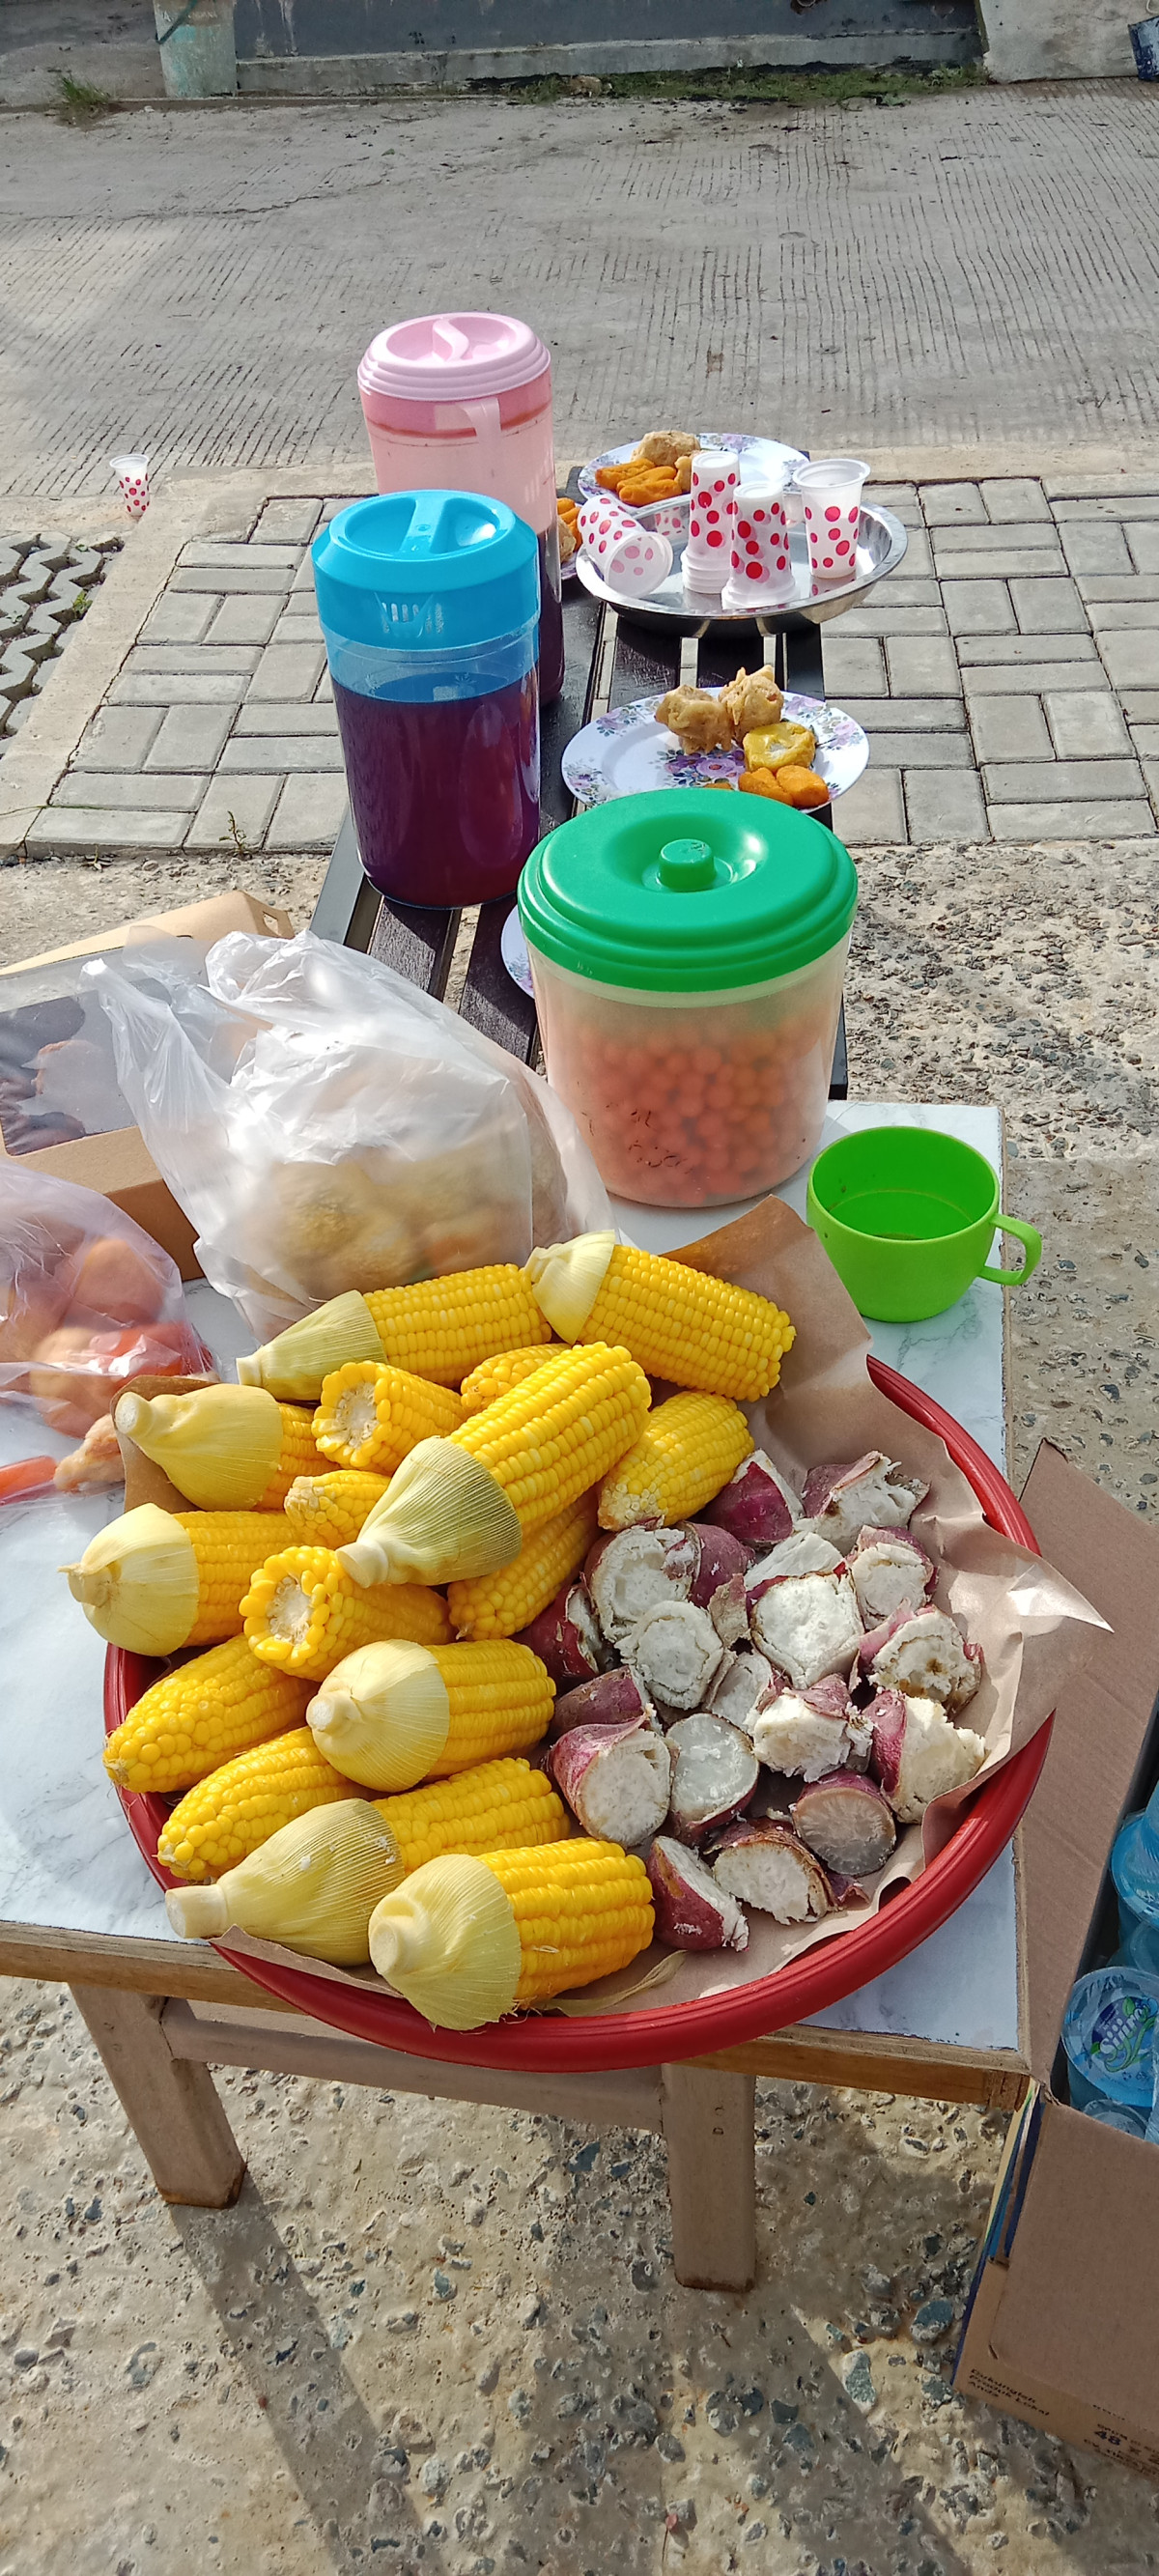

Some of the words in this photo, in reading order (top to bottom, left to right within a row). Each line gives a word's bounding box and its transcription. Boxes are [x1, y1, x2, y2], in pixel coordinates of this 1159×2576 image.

[968, 2381, 999, 2397] Anda
[969, 2375, 1012, 2397] Produk
[1016, 2396, 1050, 2416] Lokal
[1094, 2430, 1120, 2446] 48
